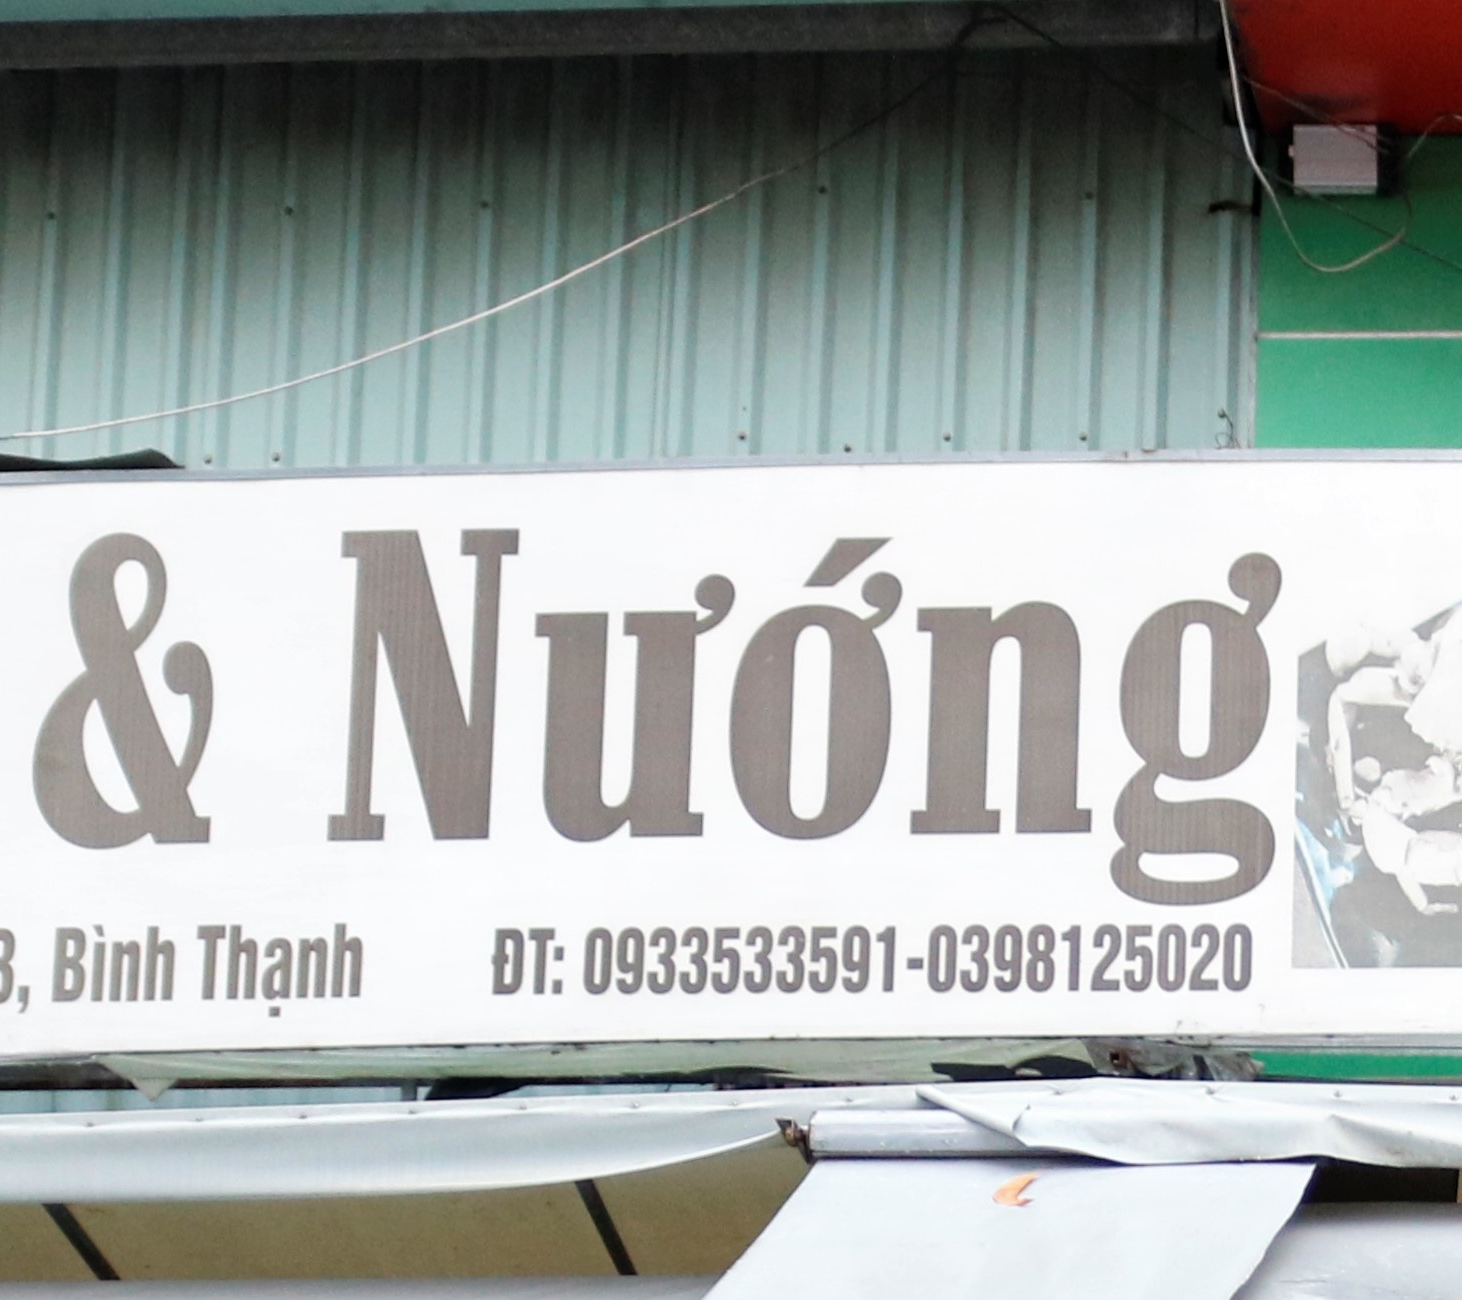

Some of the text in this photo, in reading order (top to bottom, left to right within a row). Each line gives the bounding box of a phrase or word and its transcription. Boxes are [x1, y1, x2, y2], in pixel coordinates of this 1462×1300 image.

[32, 531, 215, 849] &
[327, 529, 1282, 906] Nướng
[53, 917, 179, 1000] Bình
[197, 924, 363, 1018] Thạnh
[492, 922, 1253, 995] ĐT: 0933533591-0398125020
